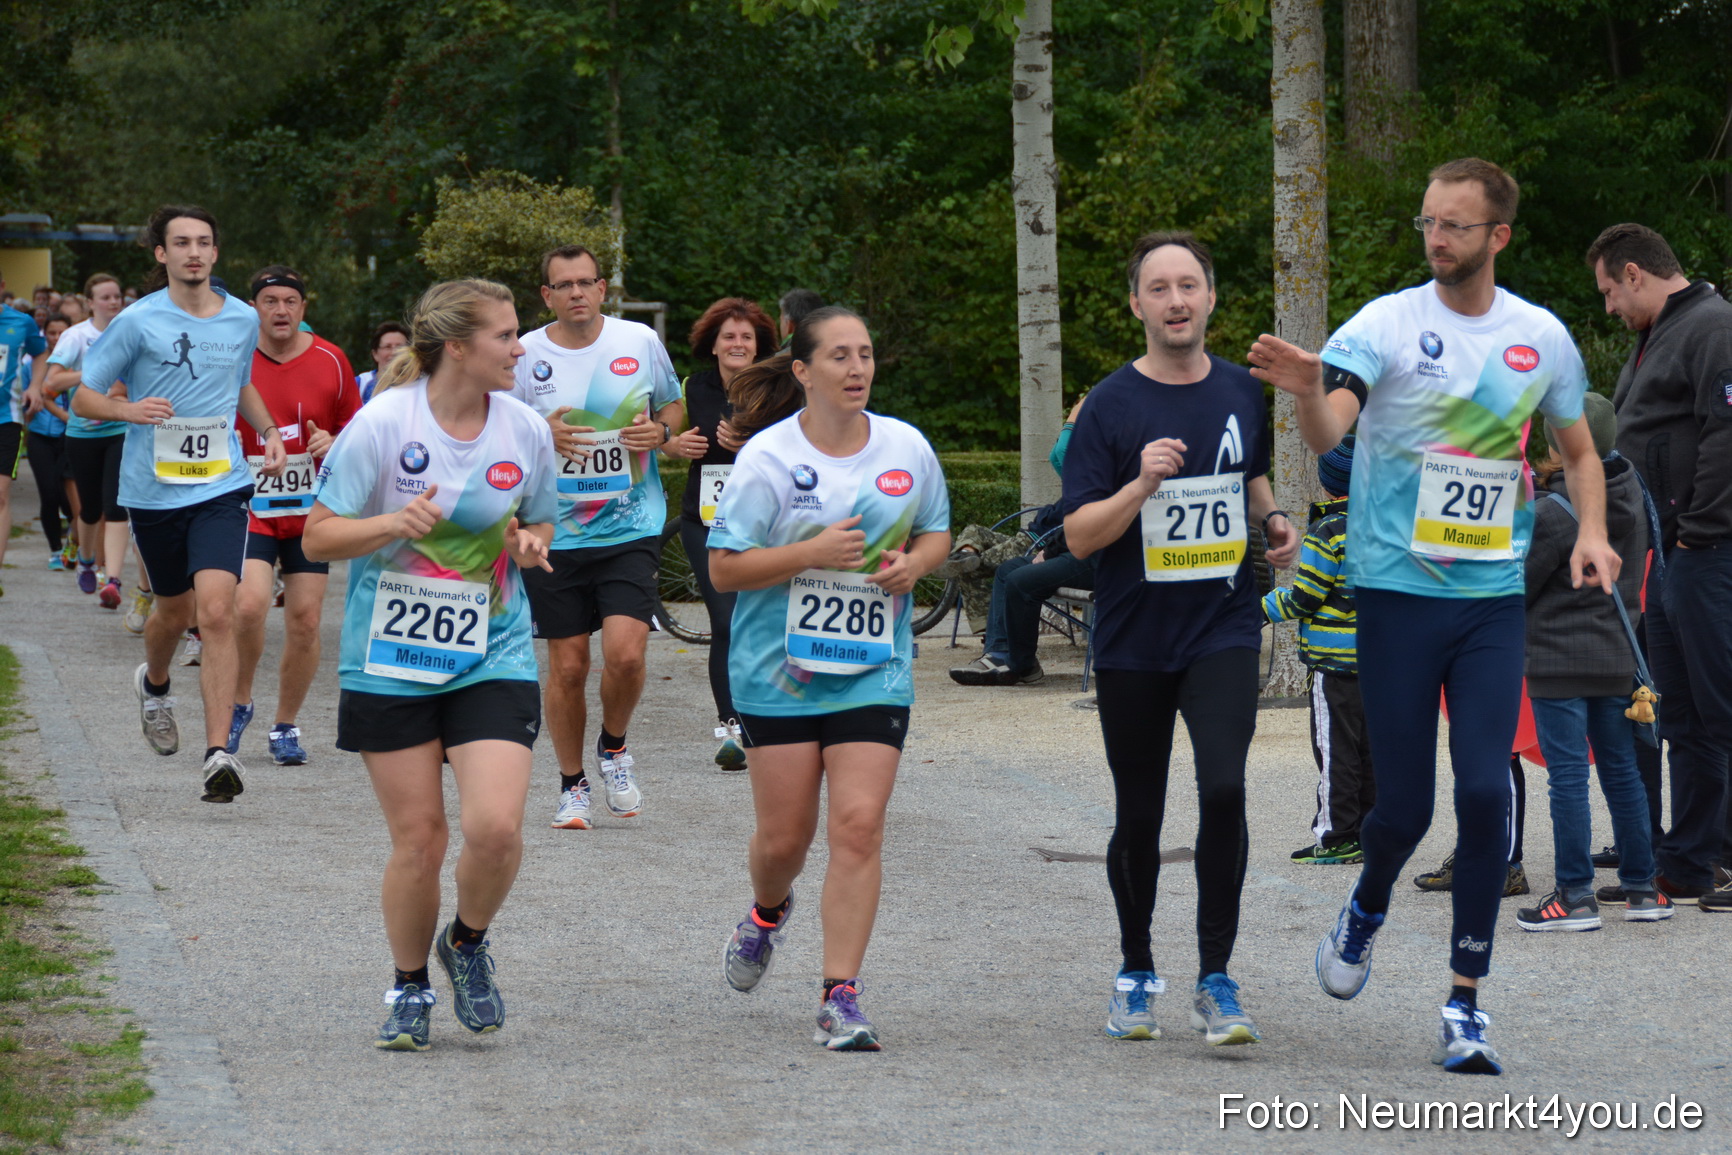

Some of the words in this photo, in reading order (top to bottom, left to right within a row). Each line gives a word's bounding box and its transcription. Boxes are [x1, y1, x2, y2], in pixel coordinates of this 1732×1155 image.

[200, 342, 224, 352] GYM
[614, 362, 637, 371] Hervis
[1507, 351, 1535, 365] Hervis
[1417, 370, 1449, 380] Neumarkt
[1418, 361, 1448, 374] PARTL
[534, 384, 556, 393] PARTL
[157, 423, 182, 431] PARTL
[185, 423, 218, 431] Neumarkt
[179, 434, 209, 459] 49
[562, 446, 622, 474] 2708
[179, 465, 208, 475] Lukas
[491, 468, 518, 484] Hervis
[1425, 461, 1462, 476] PARTL
[1465, 468, 1508, 480] Neumarkt
[255, 467, 312, 494] 2494
[396, 476, 428, 490] PARTL
[577, 481, 608, 491] Dieter
[880, 476, 910, 490] Hervis
[395, 484, 425, 496] Neumark
[1149, 489, 1180, 500] ARTL
[1182, 485, 1229, 499] Neumarkt
[1440, 480, 1504, 521] 297
[1166, 500, 1230, 541] 276
[1443, 527, 1491, 545] Manuel
[1162, 549, 1236, 567] Stolpmann
[379, 580, 416, 596] PARTL
[418, 587, 471, 602] Neumarkt
[794, 576, 829, 590] PARTL
[832, 581, 879, 595] Neumarkt
[382, 598, 479, 646] 2262
[798, 593, 885, 637] 2286
[395, 647, 456, 670] Melanie
[811, 641, 868, 661] Melanie
